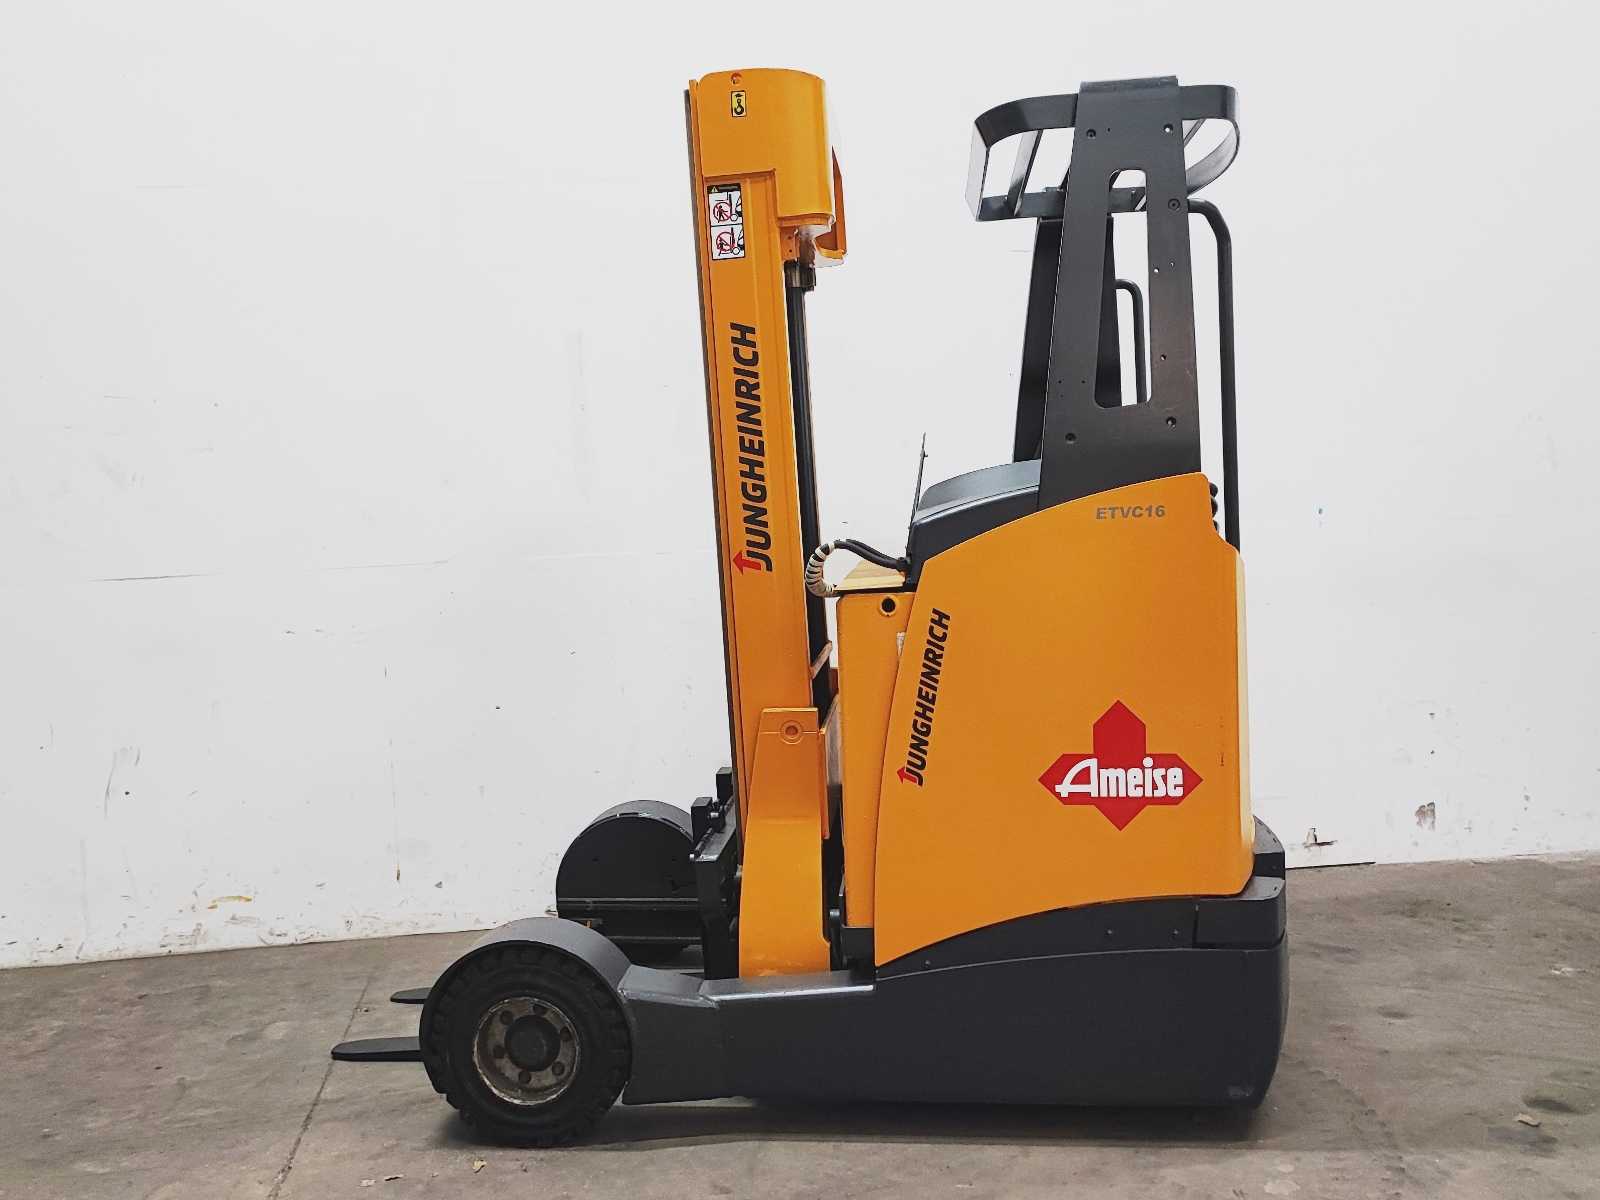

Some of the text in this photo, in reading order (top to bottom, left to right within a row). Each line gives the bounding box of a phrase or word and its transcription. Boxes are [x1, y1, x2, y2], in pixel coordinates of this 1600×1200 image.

[730, 322, 772, 572] JUNGHEINRICH
[1096, 505, 1166, 520] ETVC16
[904, 607, 951, 786] JUNGHEINRICH
[1055, 756, 1184, 798] Ameise
